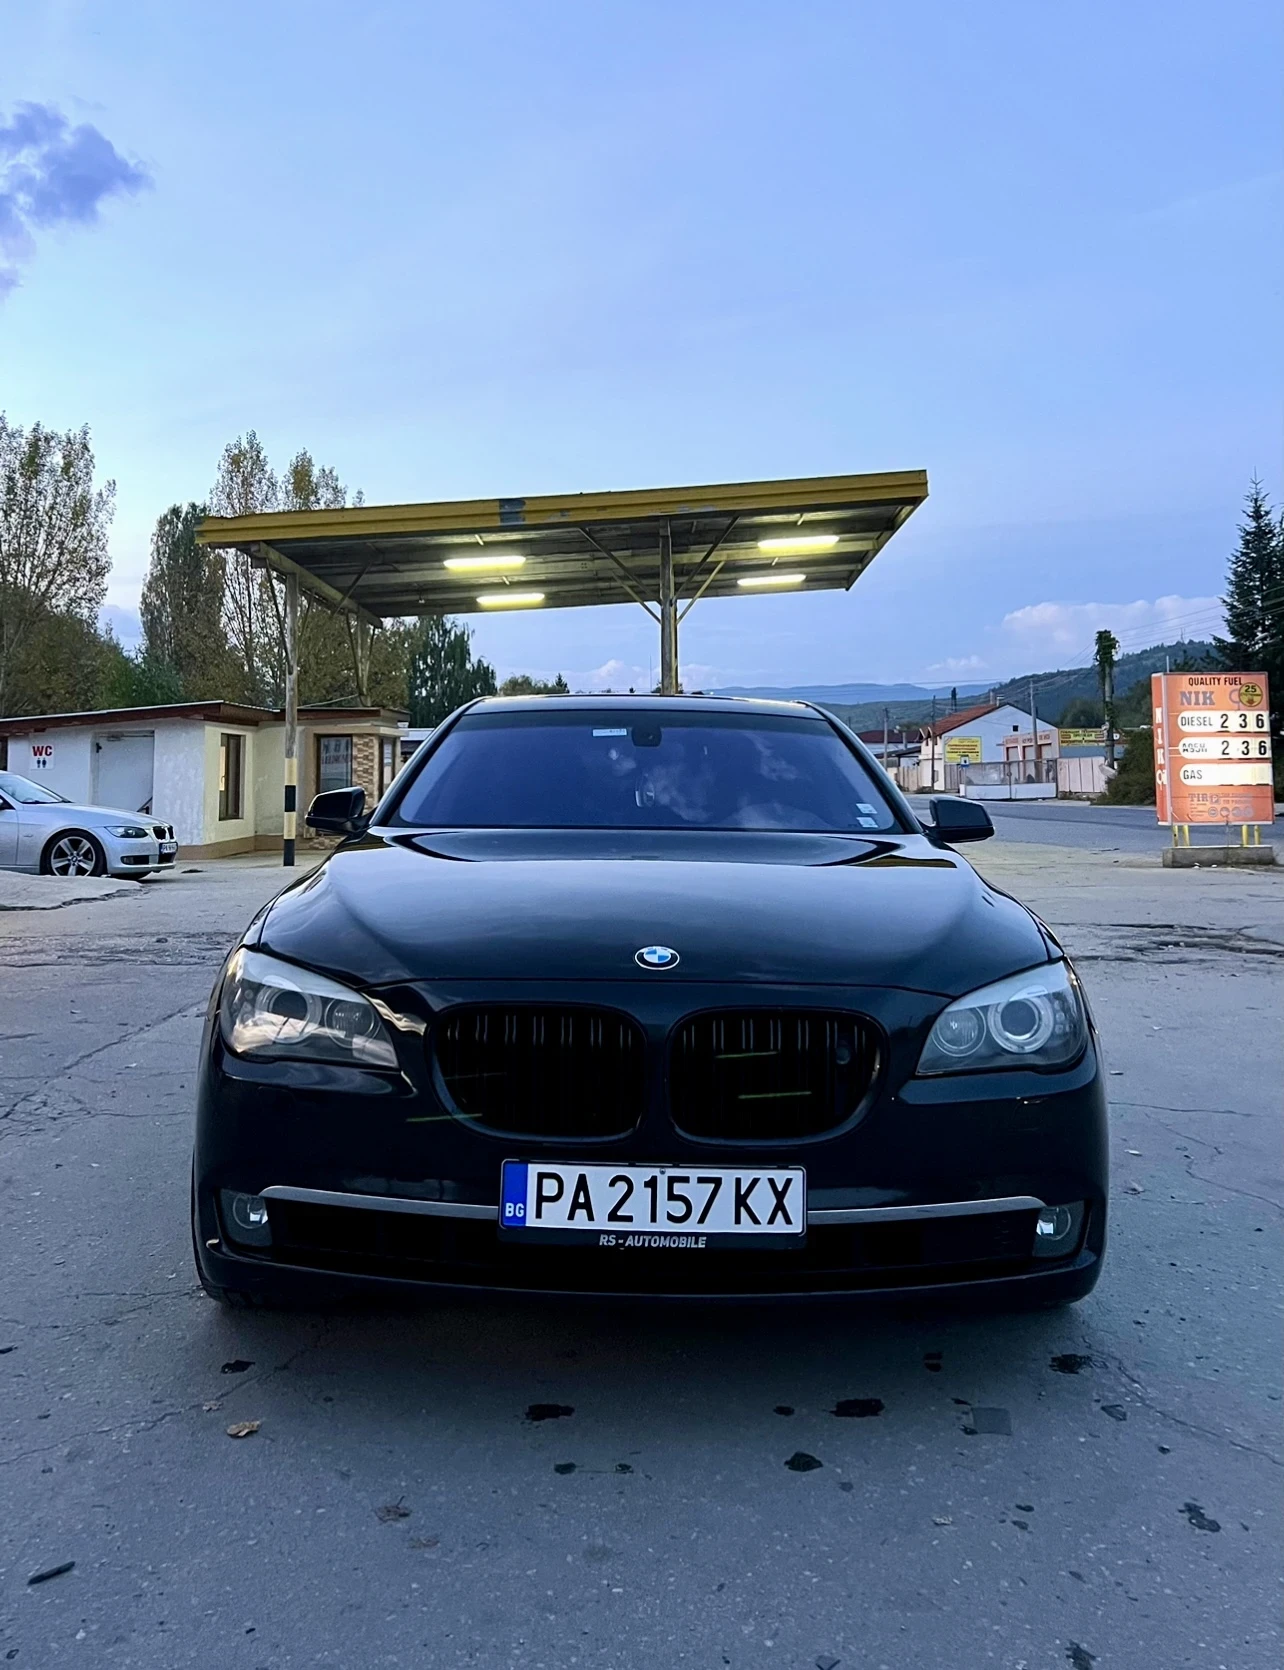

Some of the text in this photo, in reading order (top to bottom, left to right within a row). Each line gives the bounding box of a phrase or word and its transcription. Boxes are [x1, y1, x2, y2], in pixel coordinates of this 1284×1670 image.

[1188, 677, 1243, 686] QUALITY FUEL
[1244, 685, 1257, 693] 25
[1180, 691, 1215, 706] NIK
[1180, 716, 1213, 727] DIESEL
[32, 745, 53, 757] WC
[1183, 769, 1203, 780] GAS
[1188, 793, 1209, 803] TIR
[534, 1171, 793, 1226] PA 2157 KX
[504, 1202, 525, 1217] BG
